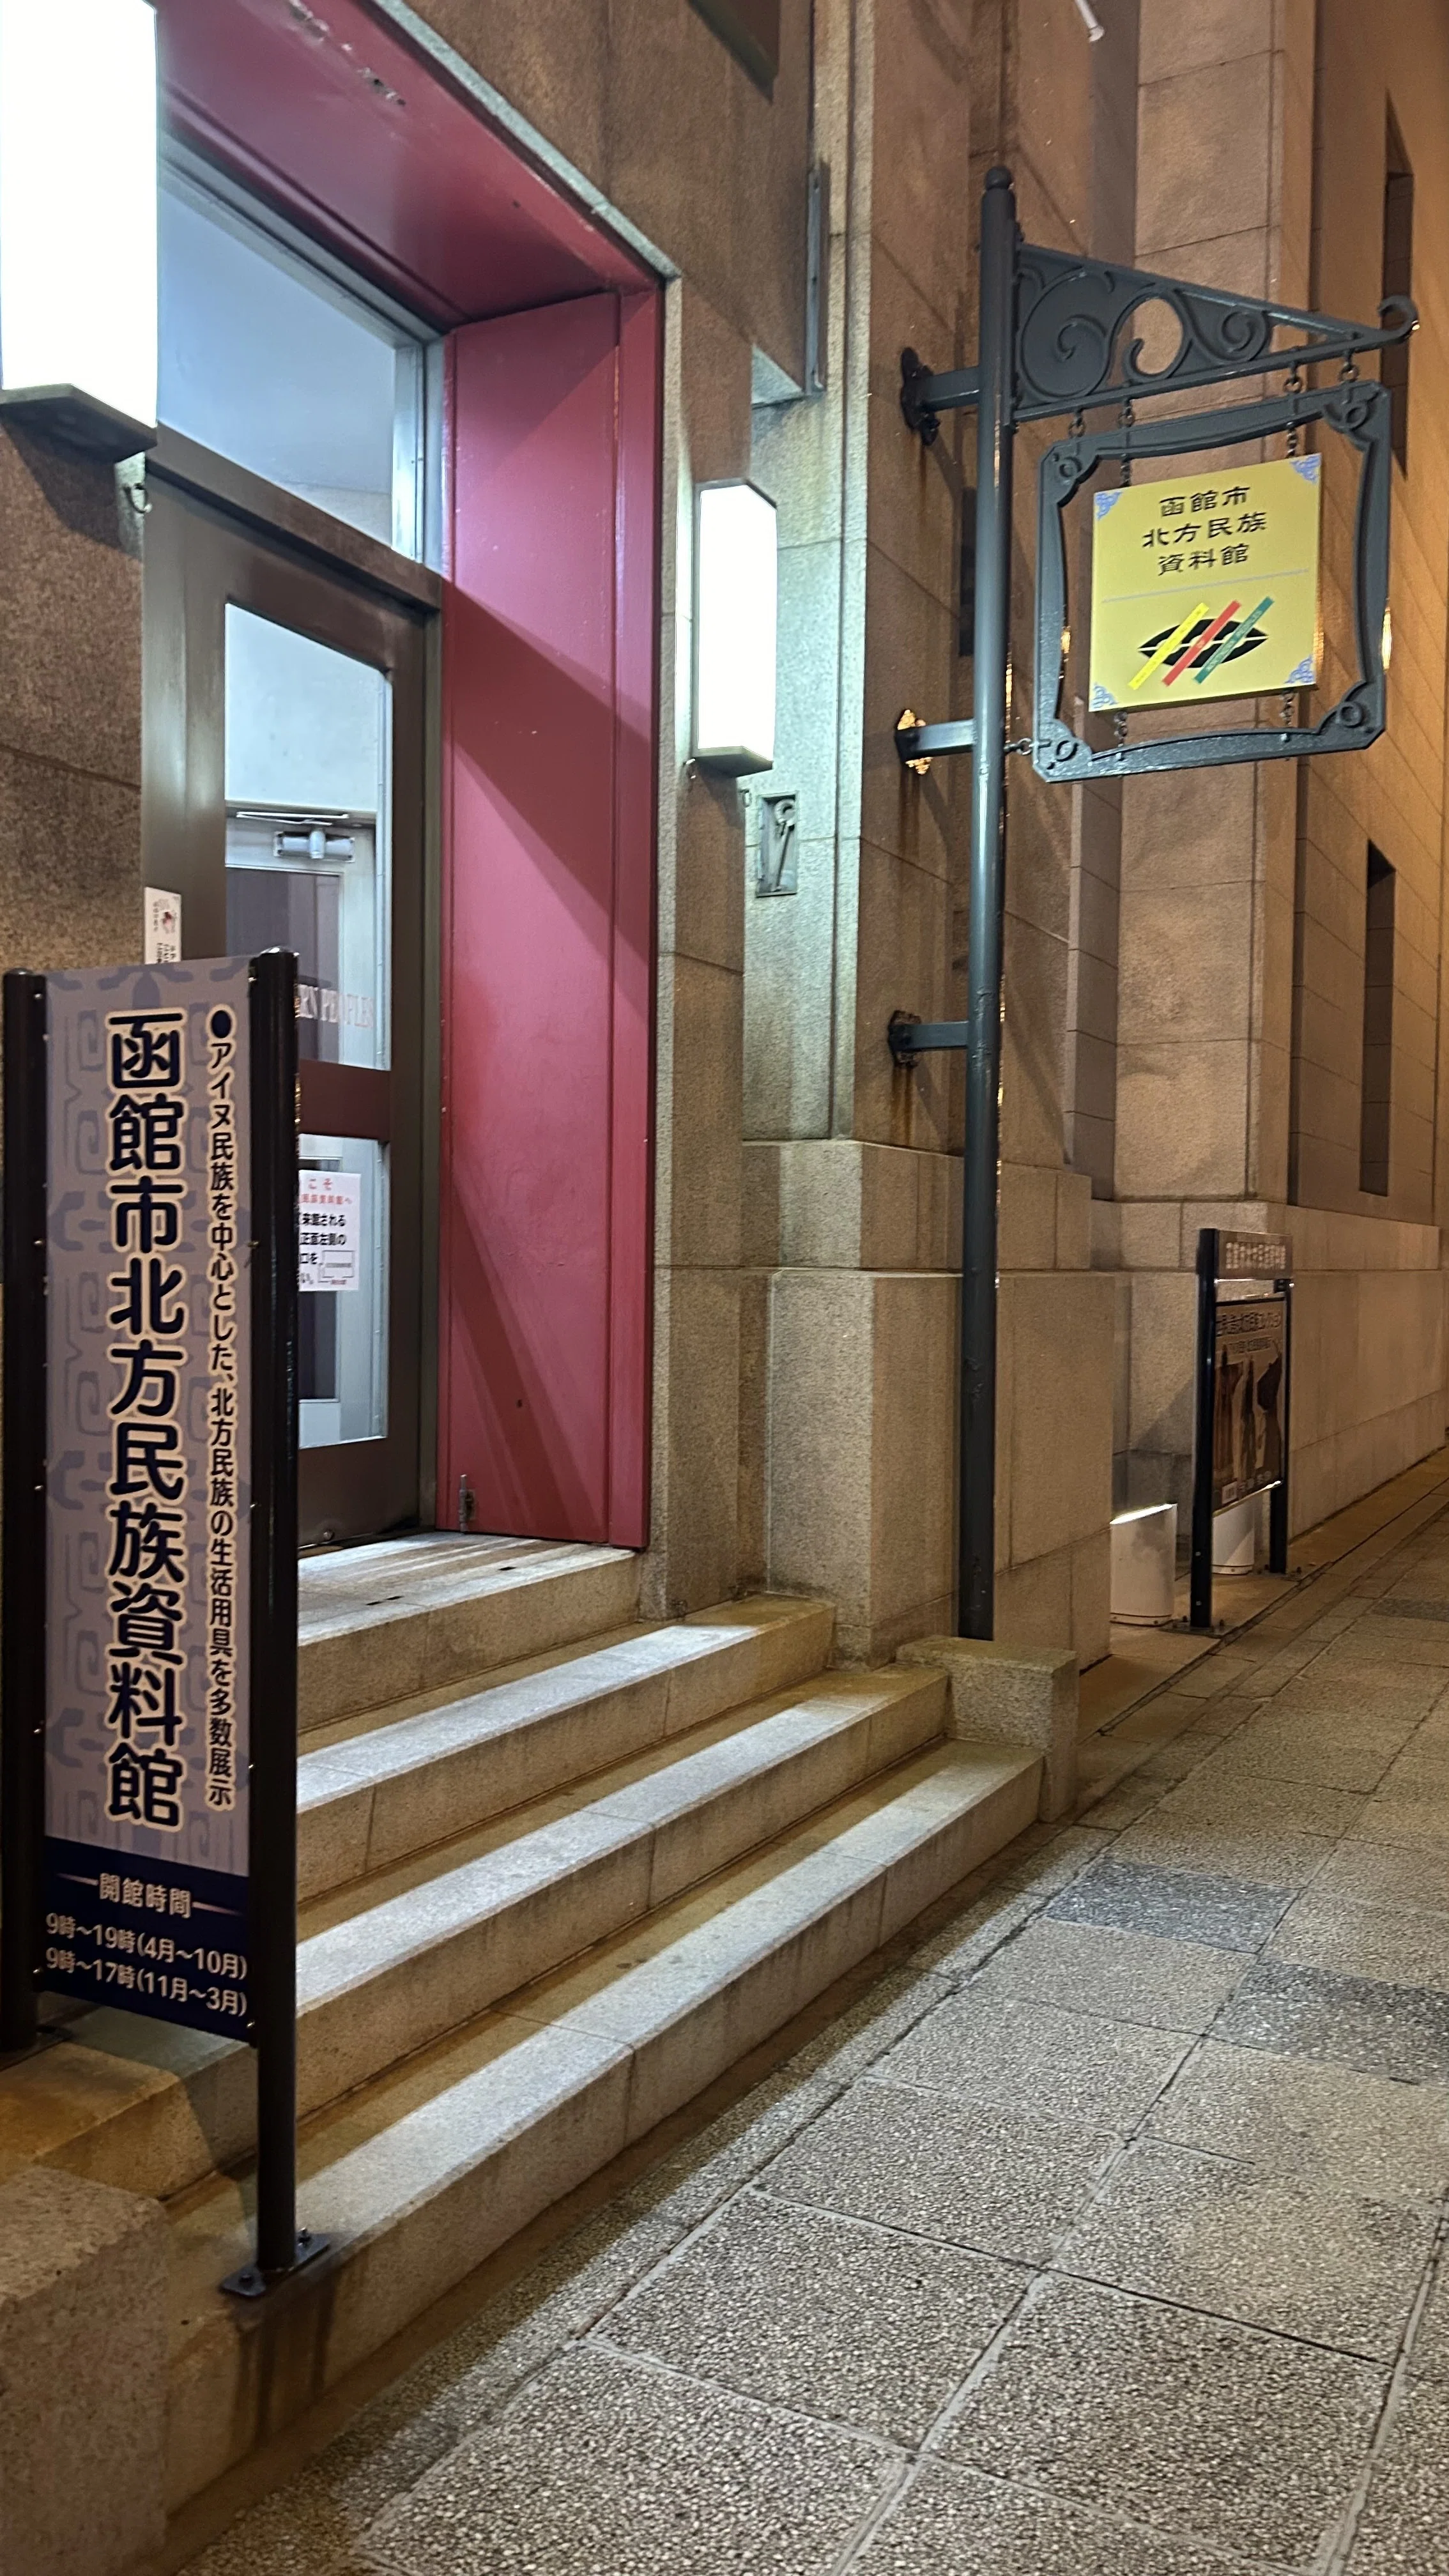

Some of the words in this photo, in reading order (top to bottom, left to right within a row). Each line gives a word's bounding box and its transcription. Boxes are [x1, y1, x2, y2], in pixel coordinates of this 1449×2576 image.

[1159, 486, 1250, 518] 函館市
[1142, 511, 1268, 548] 北方民族
[1158, 543, 1250, 576] 資料館
[107, 1011, 185, 1828] 函館市北方民族資料館
[99, 1873, 192, 1919] 開館時間
